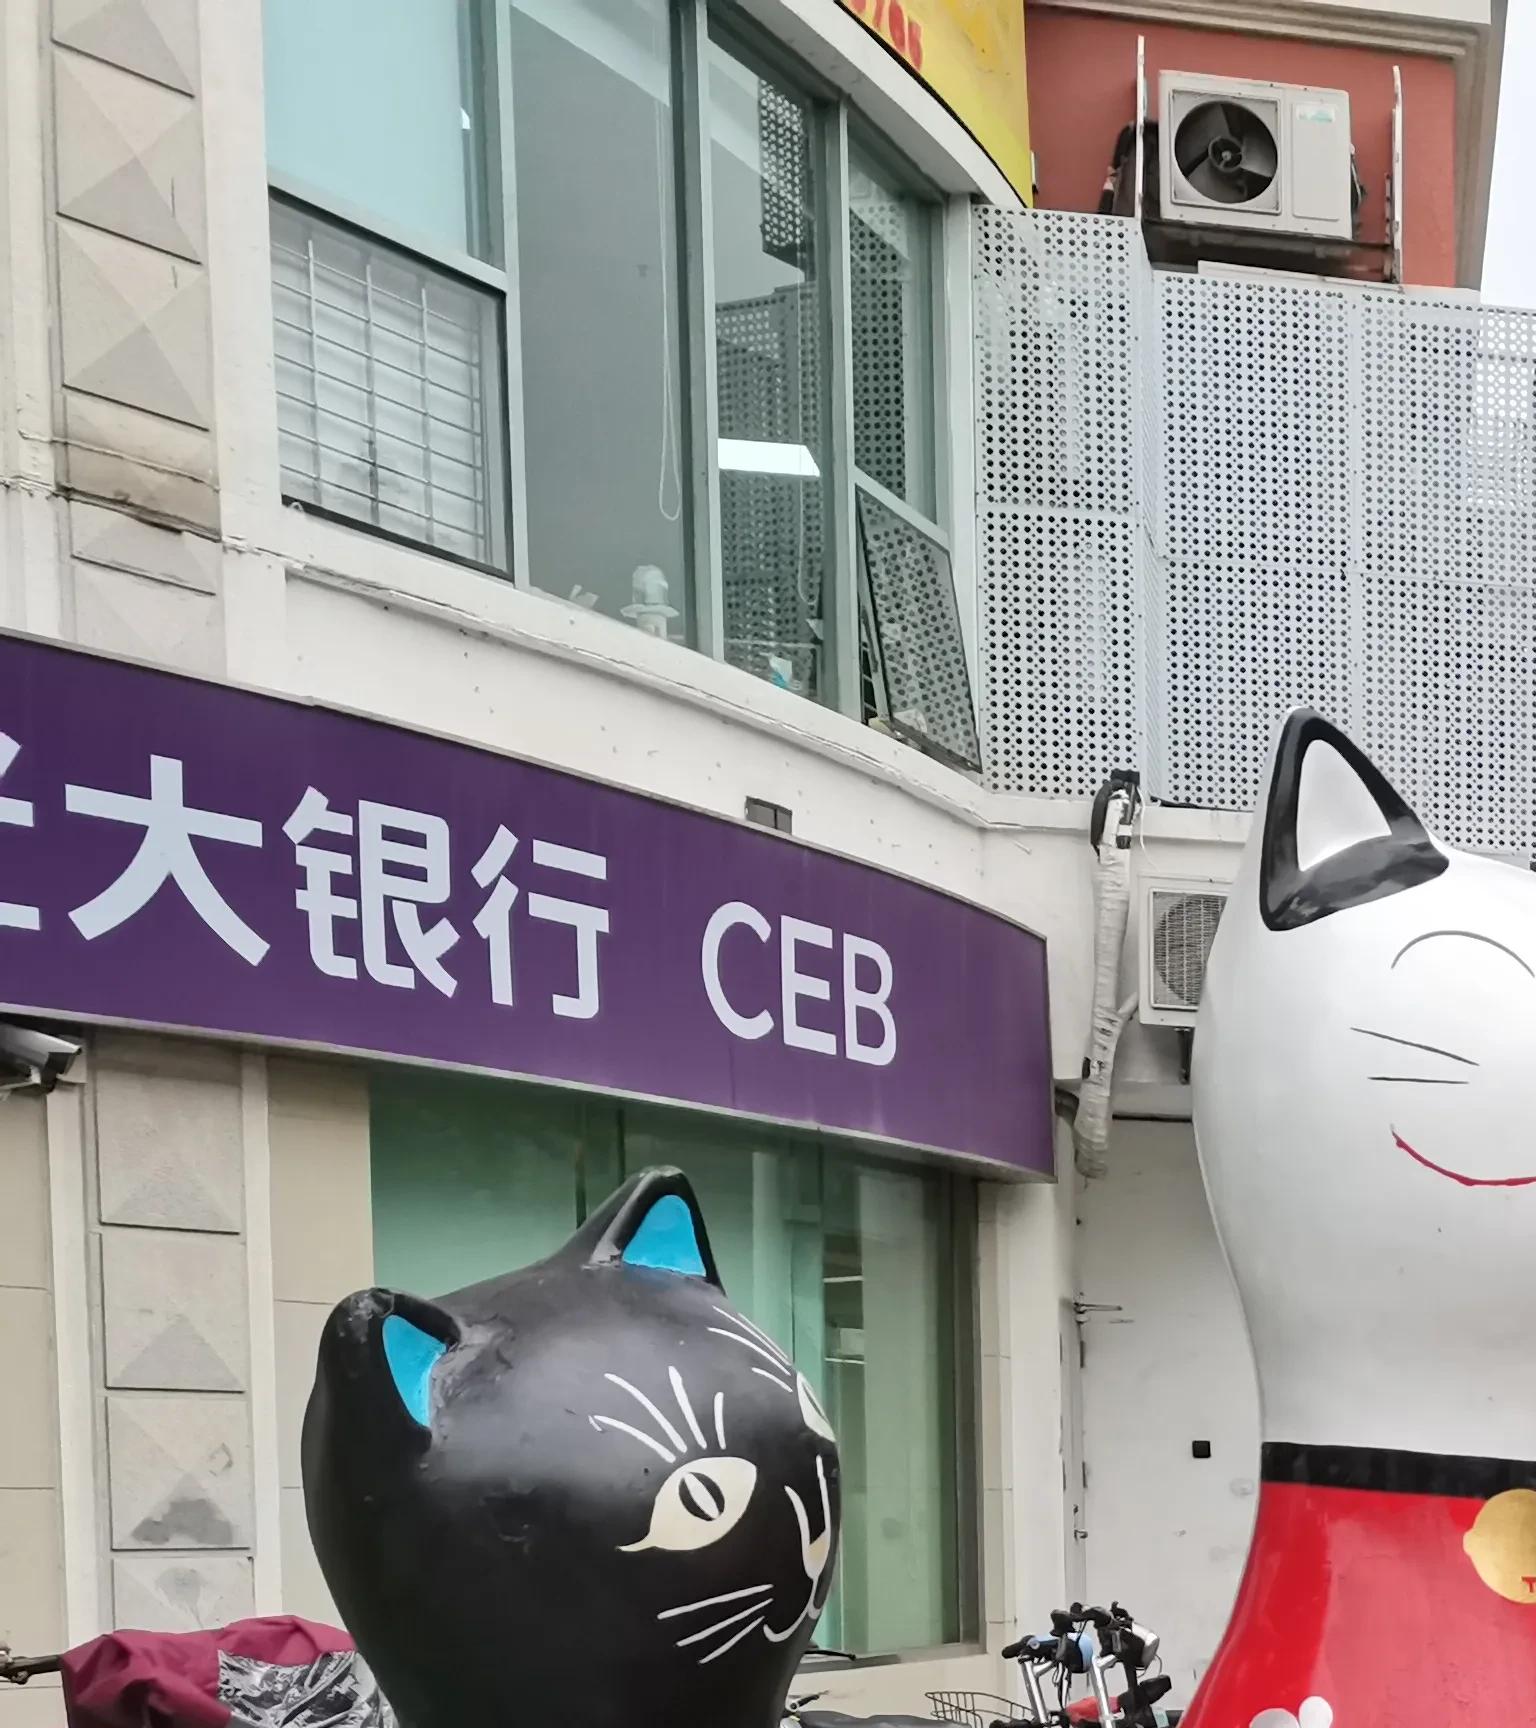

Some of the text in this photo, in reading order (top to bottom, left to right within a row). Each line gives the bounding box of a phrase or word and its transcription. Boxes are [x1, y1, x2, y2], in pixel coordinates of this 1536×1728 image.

[0, 730, 898, 1067] 大银行 CEB
